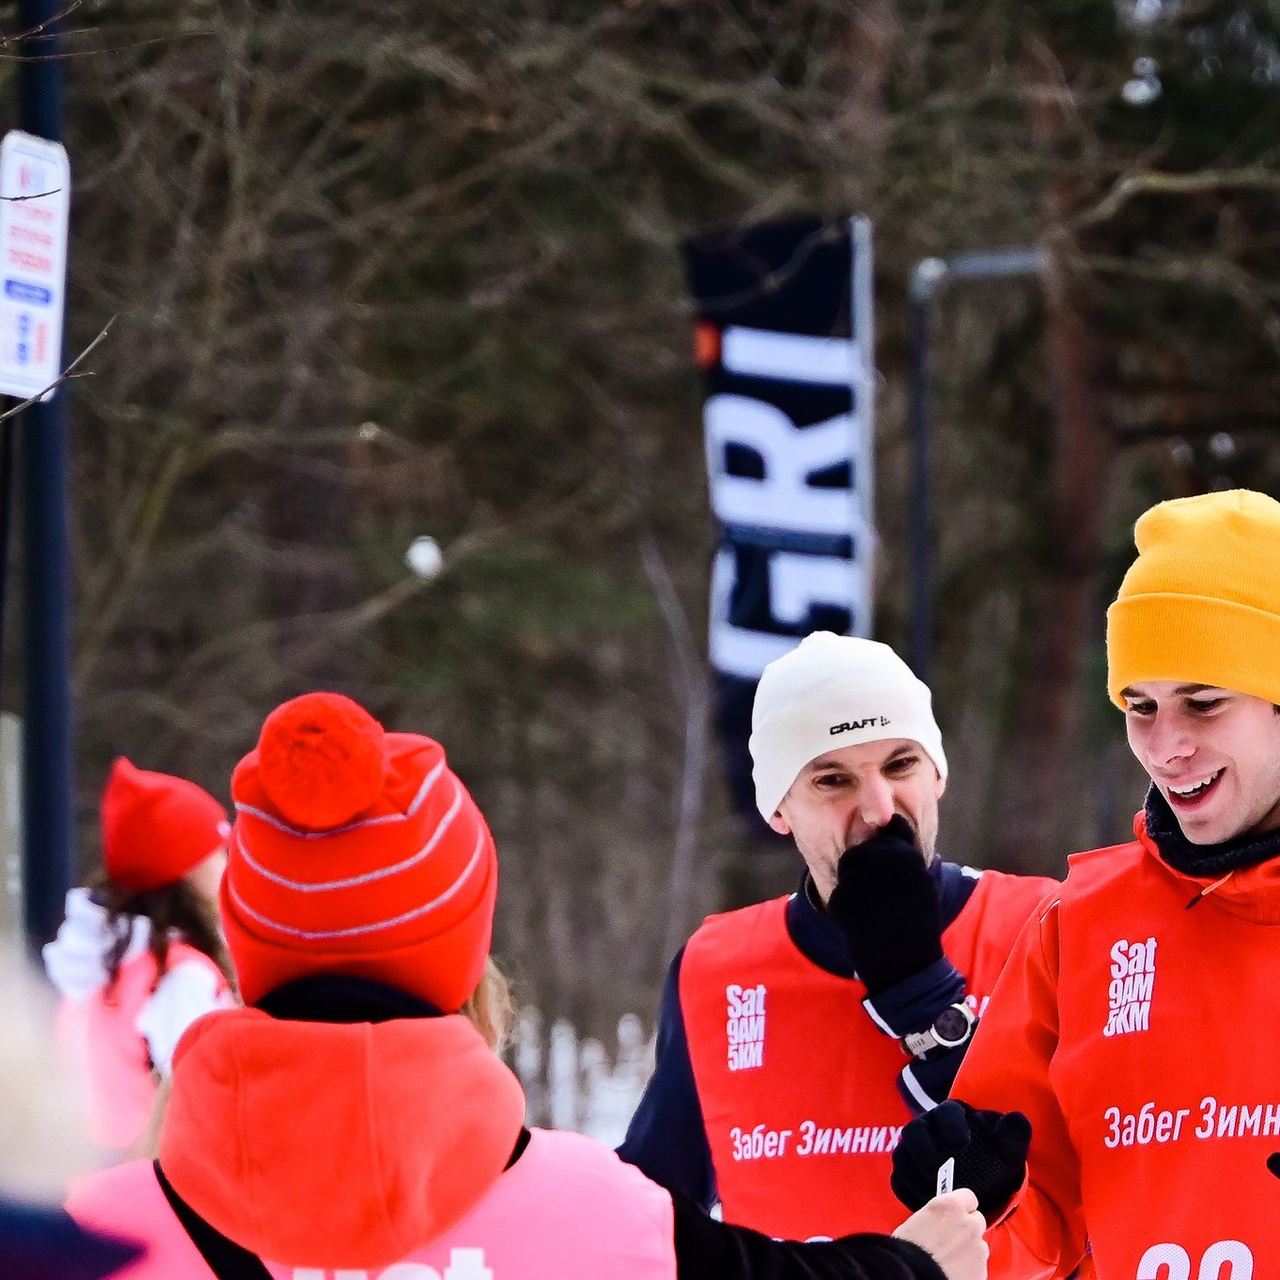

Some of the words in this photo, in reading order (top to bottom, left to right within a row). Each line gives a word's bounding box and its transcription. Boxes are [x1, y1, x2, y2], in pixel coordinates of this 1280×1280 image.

[829, 718, 877, 735] CRAFT
[1110, 937, 1157, 979] Sat
[726, 984, 767, 1018] Sat
[1108, 973, 1154, 1009] 9AM
[726, 1015, 765, 1044] 9AM
[1103, 1001, 1152, 1037] 5KM
[727, 1041, 763, 1071] 5KM
[729, 1124, 792, 1161] Забег
[796, 1121, 905, 1155] Зимних
[1103, 1101, 1189, 1148] Забег
